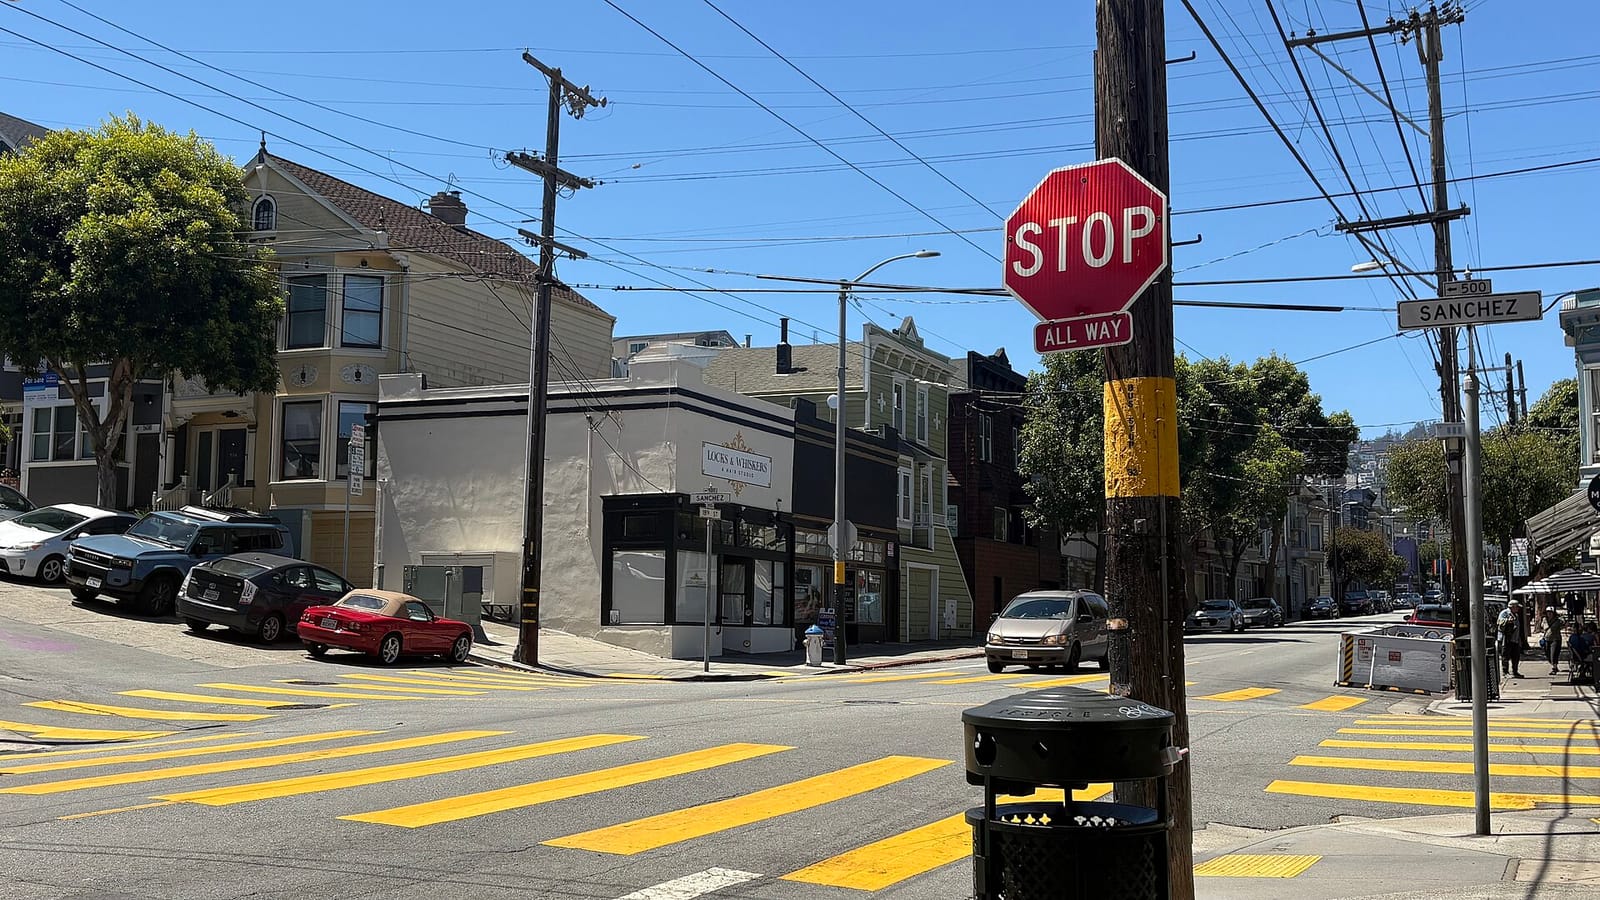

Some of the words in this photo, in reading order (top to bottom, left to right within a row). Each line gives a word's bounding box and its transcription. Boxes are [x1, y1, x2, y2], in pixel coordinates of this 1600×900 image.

[1012, 206, 1156, 278] STOP
[1461, 282, 1486, 294] 500
[1420, 299, 1518, 321] SANCHEZ
[1044, 326, 1076, 347] ALL
[1085, 319, 1122, 341] WAY
[707, 450, 729, 465] LOCKS
[730, 457, 734, 466] &
[736, 456, 767, 473] WHISKERS
